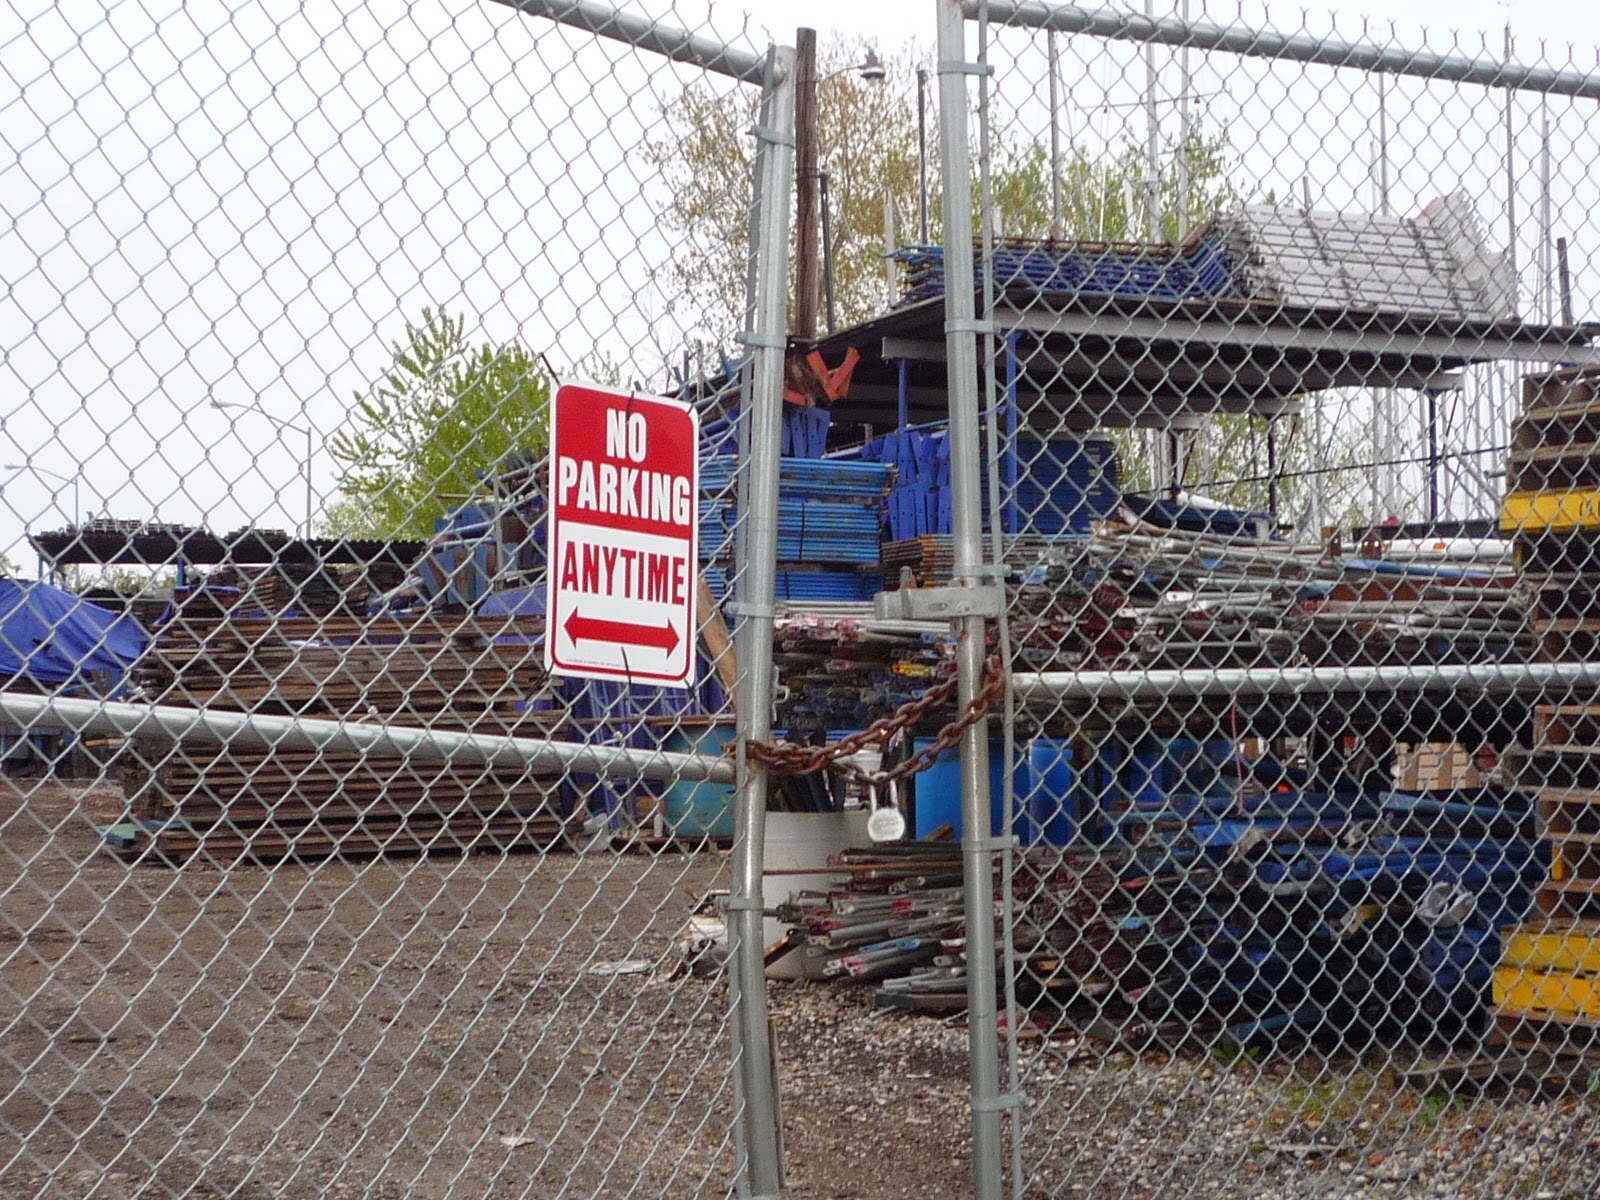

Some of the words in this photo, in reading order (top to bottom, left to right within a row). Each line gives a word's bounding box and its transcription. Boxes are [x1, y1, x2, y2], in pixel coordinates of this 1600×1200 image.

[606, 408, 647, 462] NO
[558, 456, 690, 525] PARKING
[561, 540, 685, 605] ANYTIME
